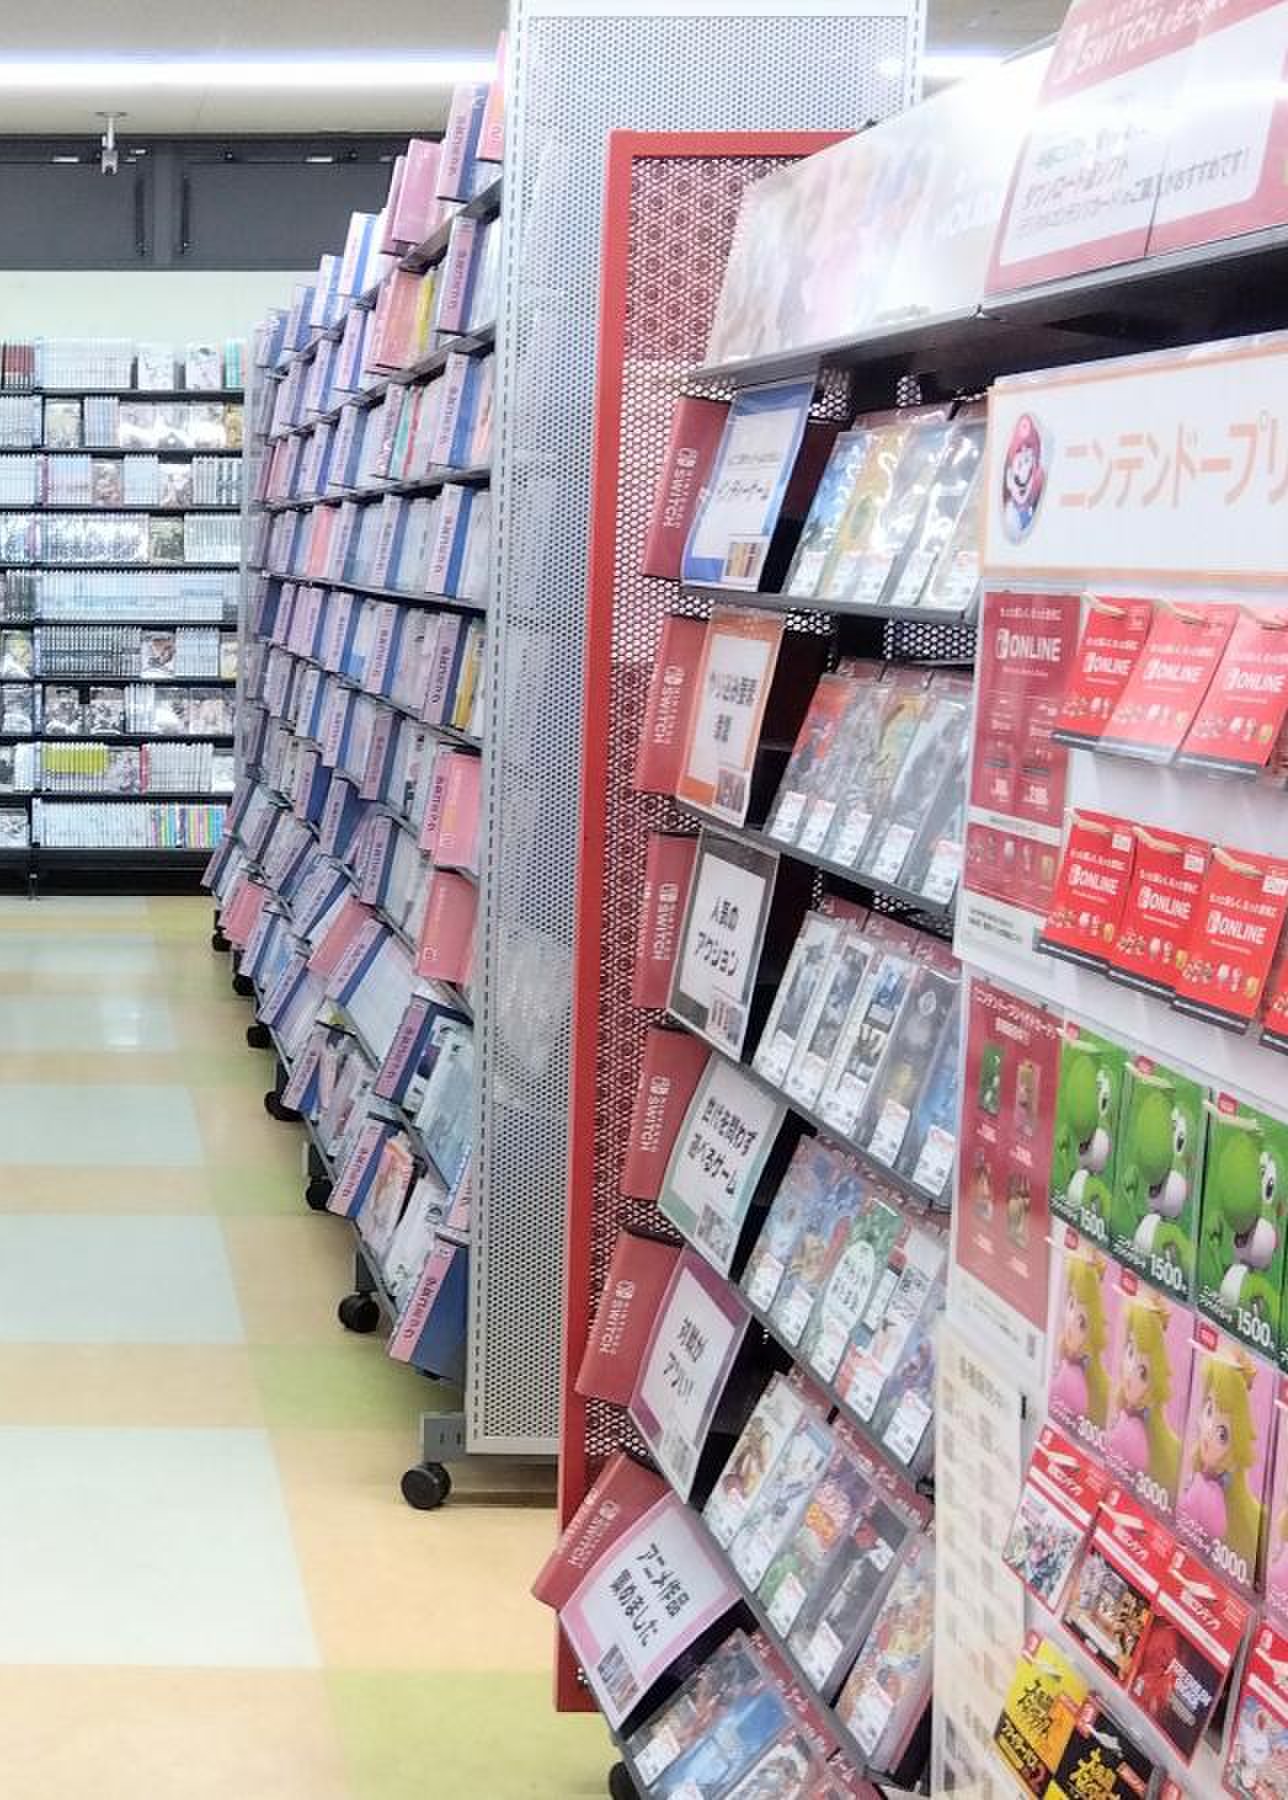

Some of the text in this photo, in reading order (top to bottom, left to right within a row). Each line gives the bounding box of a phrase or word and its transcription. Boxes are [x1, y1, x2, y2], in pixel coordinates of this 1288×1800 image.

[610, 1569, 659, 1647] 集めました
[635, 1542, 690, 1617] アニメ作品
